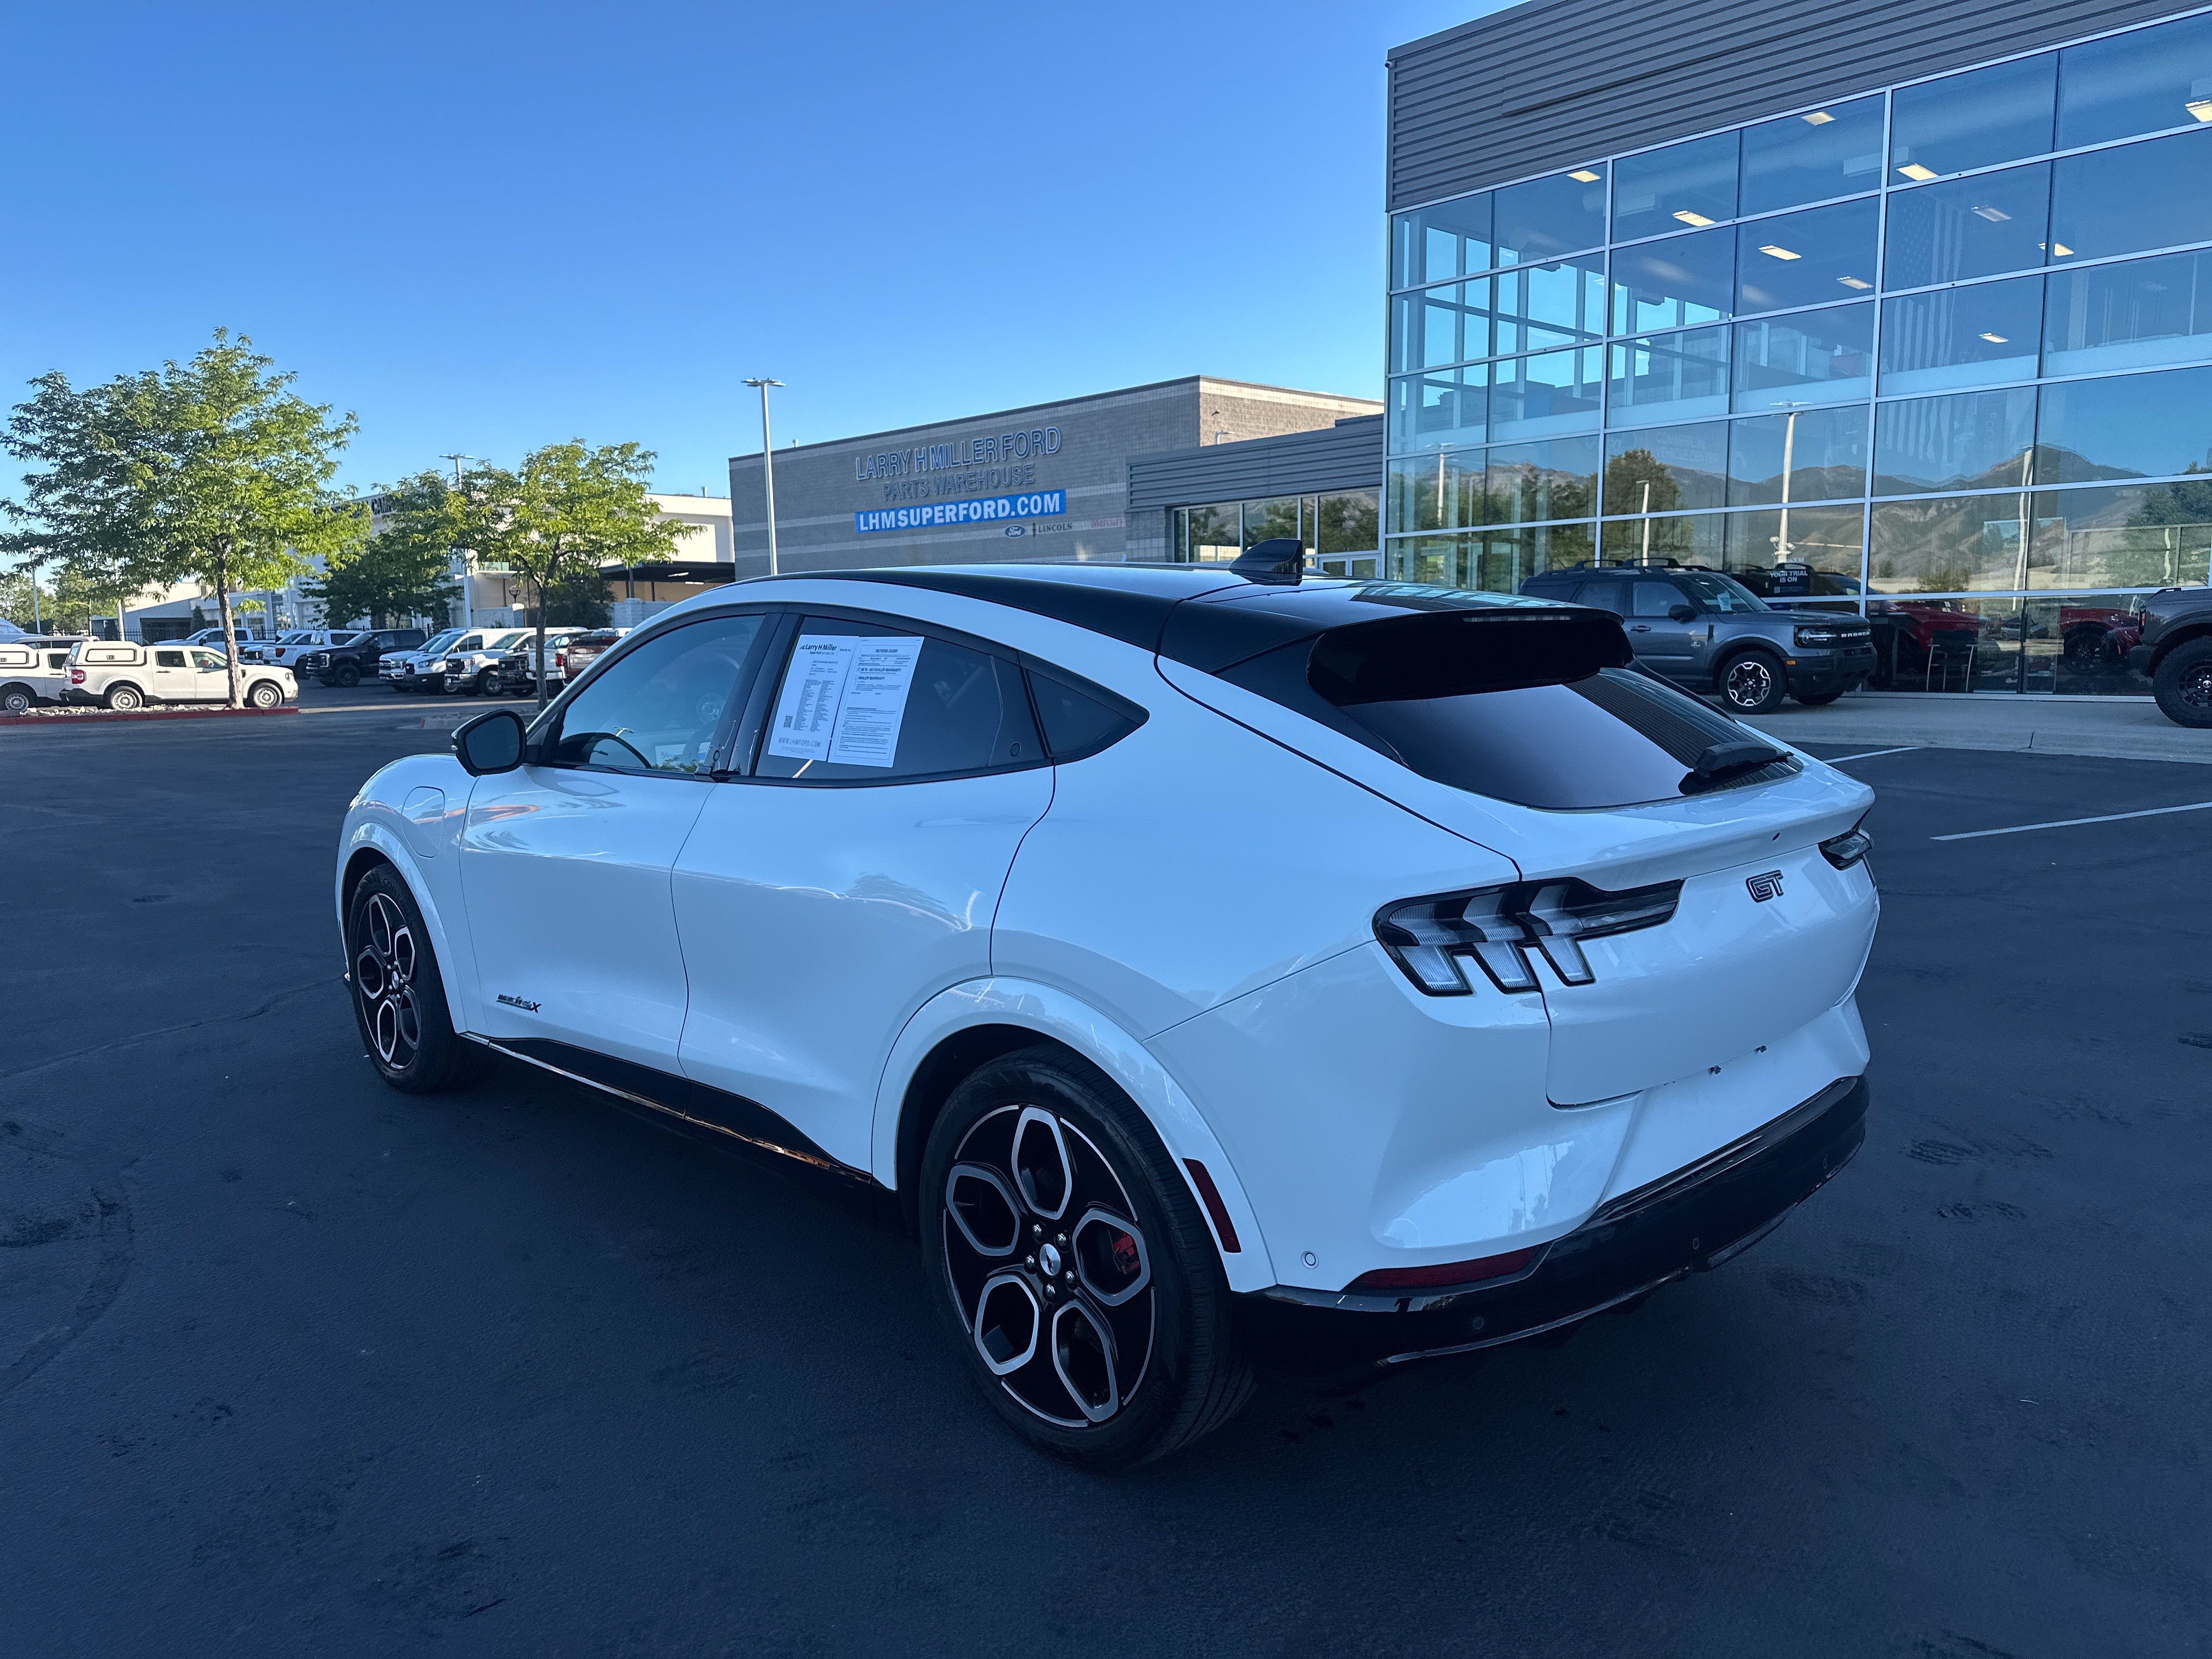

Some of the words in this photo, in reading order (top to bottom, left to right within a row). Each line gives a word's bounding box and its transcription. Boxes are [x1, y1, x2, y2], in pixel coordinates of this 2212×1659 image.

[856, 449, 911, 481] LARRY
[915, 447, 927, 472] H
[930, 437, 998, 471] MILLER
[1001, 426, 1061, 461] FORD
[882, 477, 929, 501] PARTS
[932, 464, 1036, 495] WAREHOUSE
[859, 492, 1060, 531] LHMSUPERFORD.COM
[1038, 522, 1073, 533] LINCOLN
[805, 644, 818, 652] Larry
[1746, 870, 1784, 903] GT
